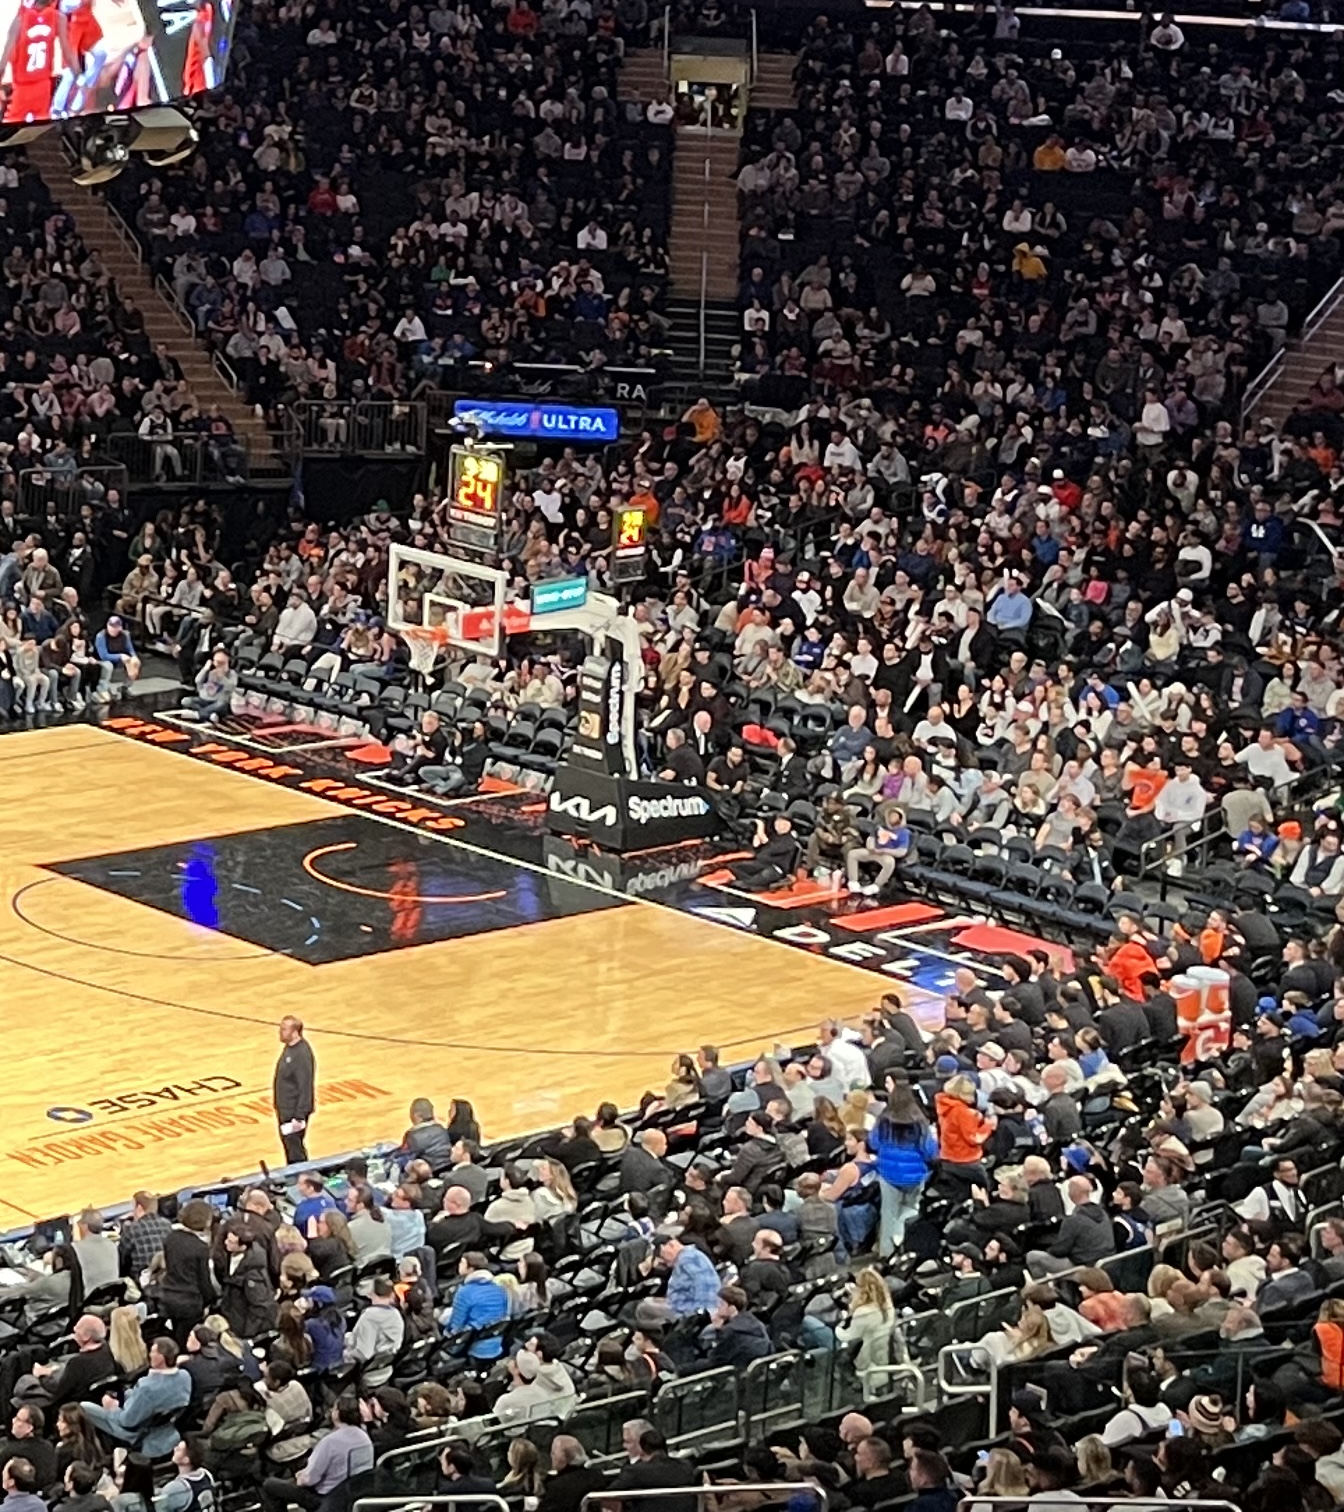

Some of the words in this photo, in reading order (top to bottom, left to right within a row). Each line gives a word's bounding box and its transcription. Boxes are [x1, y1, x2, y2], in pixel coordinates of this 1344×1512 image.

[542, 412, 607, 431] ULTRA
[457, 474, 494, 509] 24
[190, 741, 305, 779] YORK
[300, 778, 467, 831] KNICKS
[627, 794, 707, 824] Spectrum
[89, 1075, 243, 1115] CHASE
[5, 1131, 146, 1170] GARDEN
